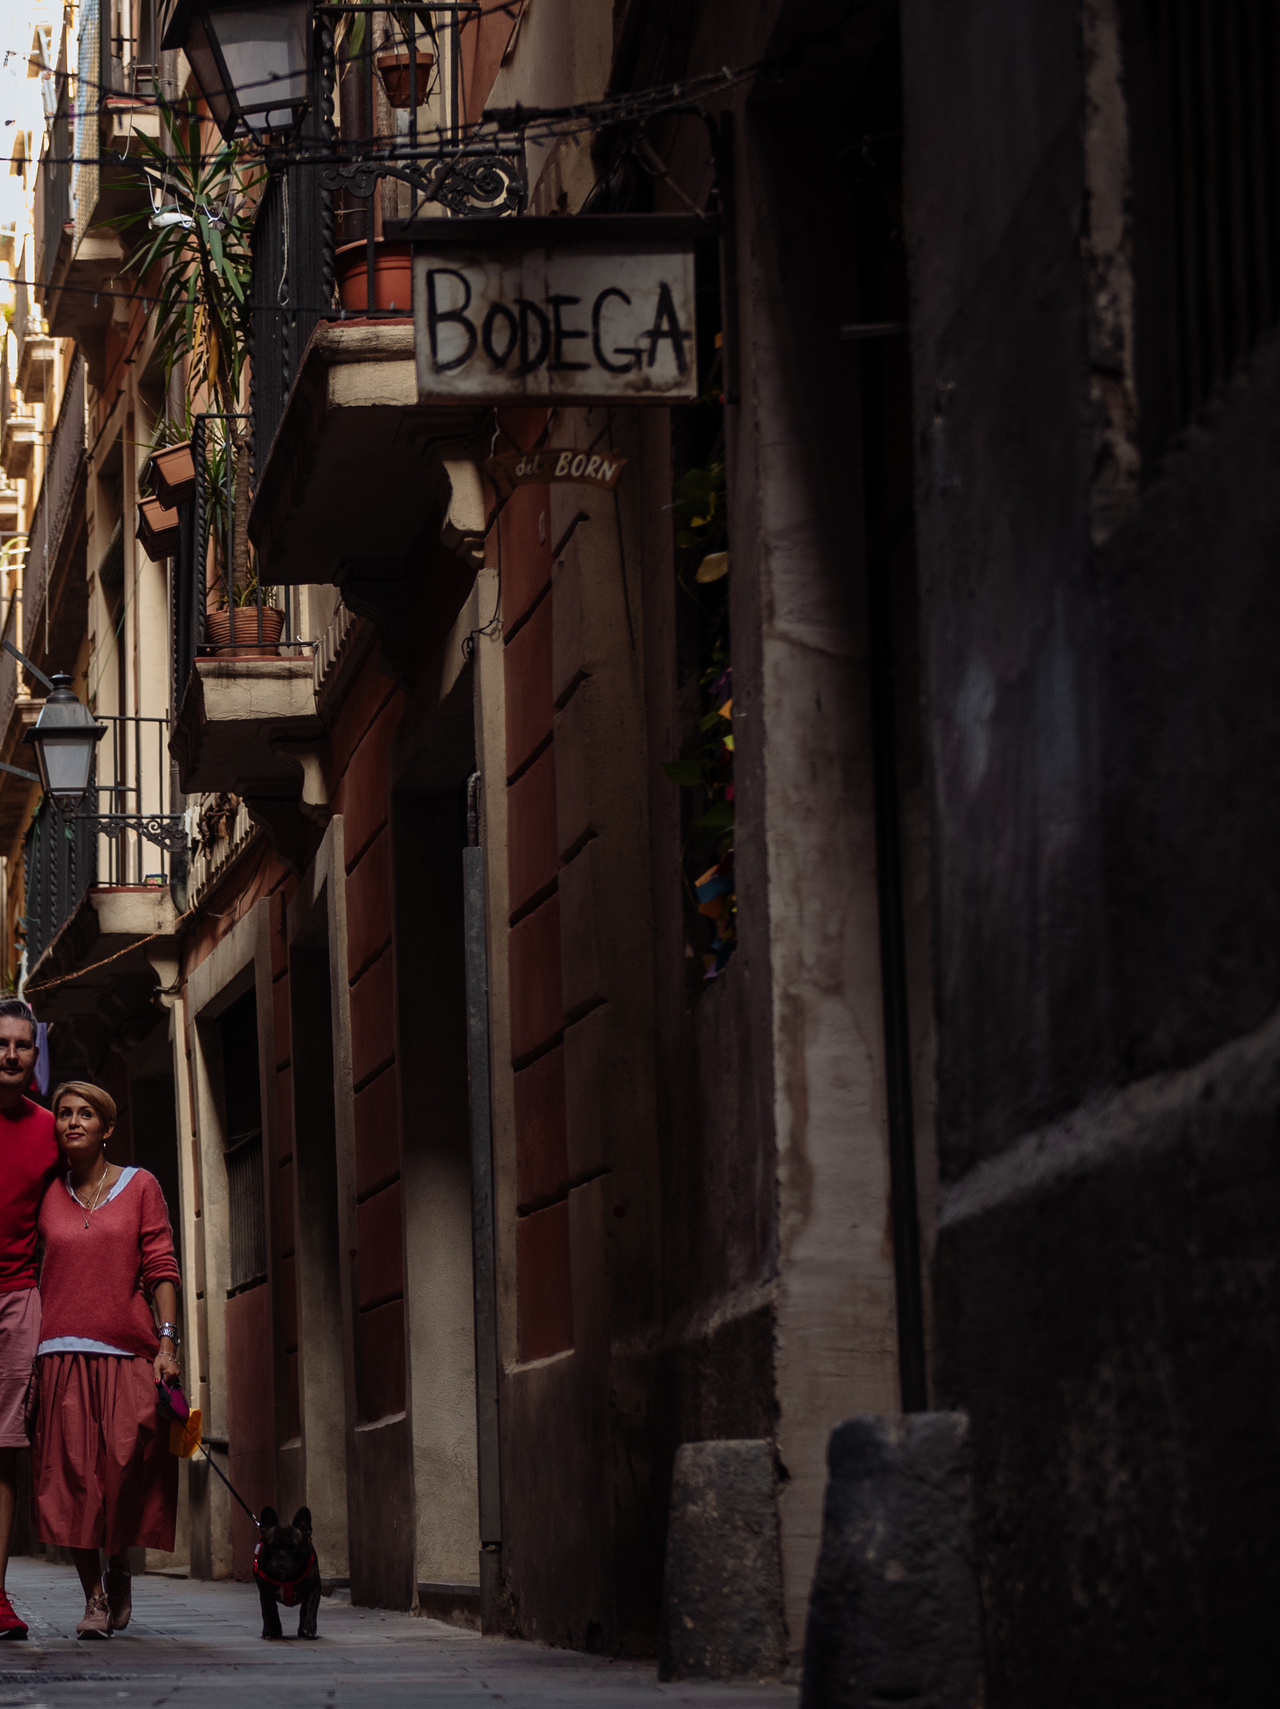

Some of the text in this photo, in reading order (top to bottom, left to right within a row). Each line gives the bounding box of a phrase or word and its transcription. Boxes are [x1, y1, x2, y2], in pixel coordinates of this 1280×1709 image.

[426, 268, 691, 377] BODEGA
[515, 451, 618, 482] del BORN
